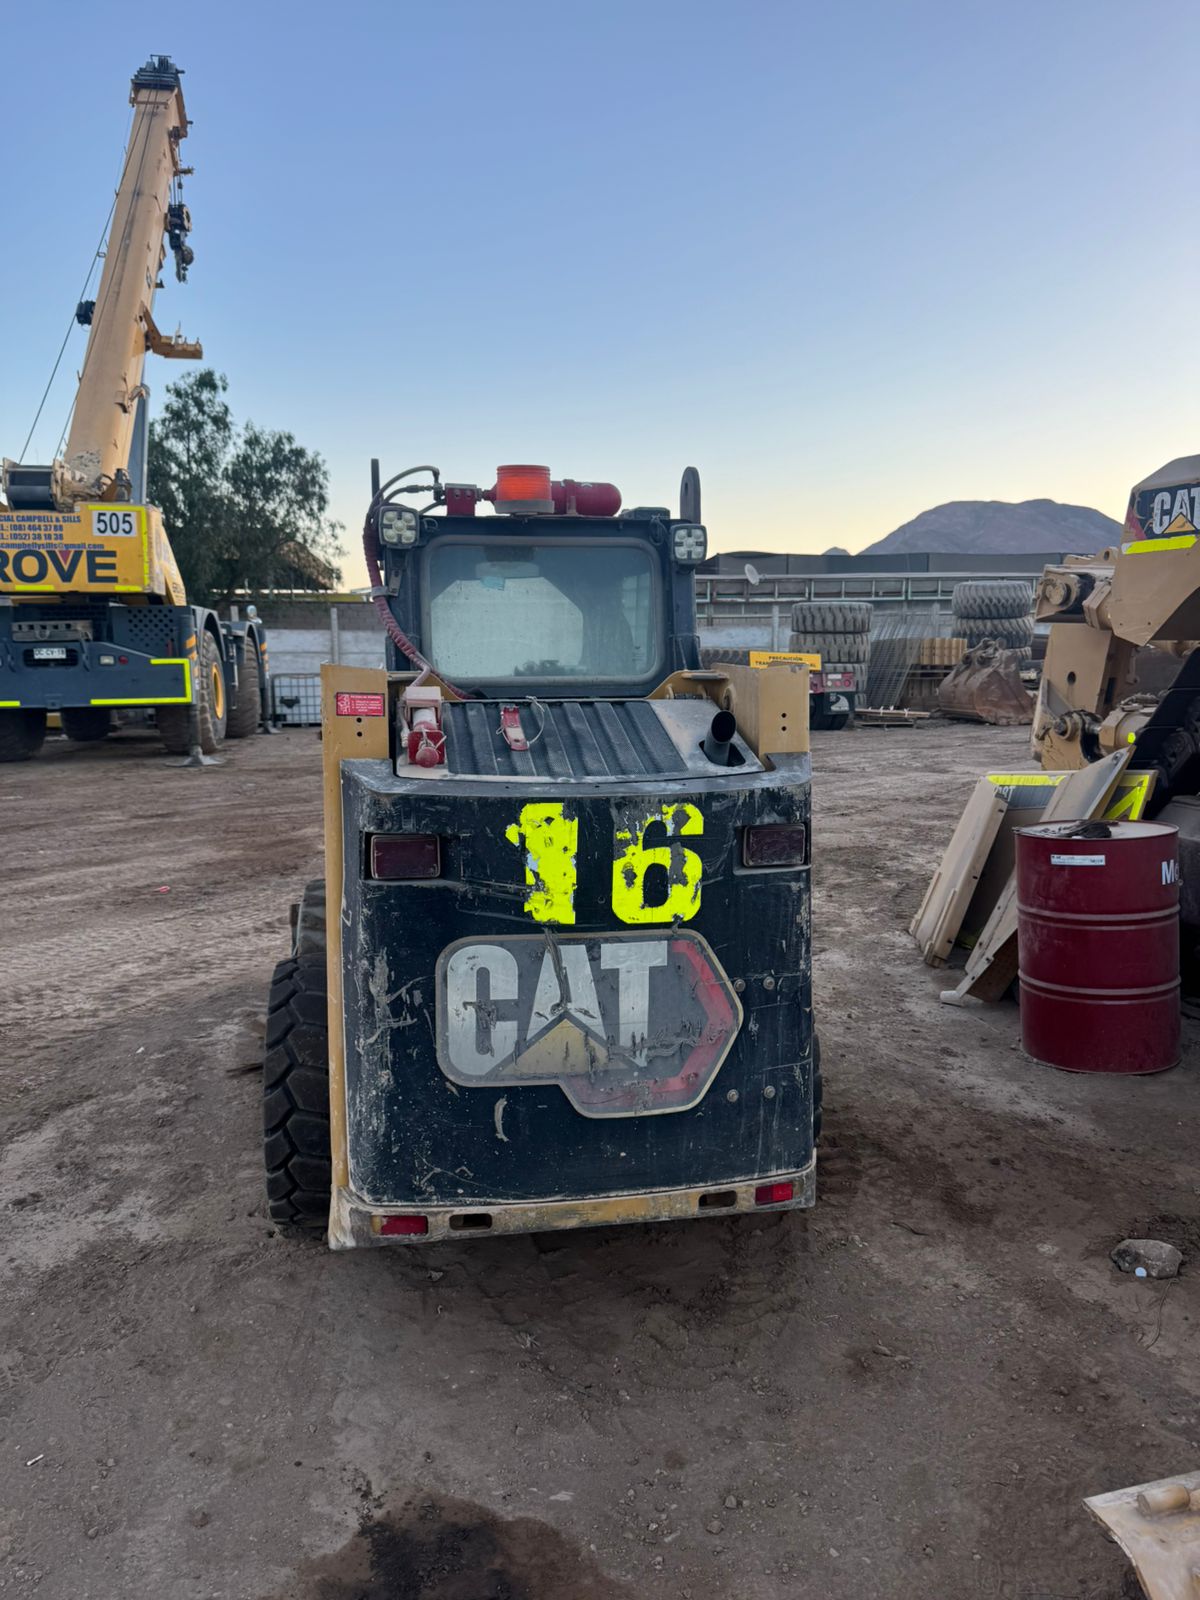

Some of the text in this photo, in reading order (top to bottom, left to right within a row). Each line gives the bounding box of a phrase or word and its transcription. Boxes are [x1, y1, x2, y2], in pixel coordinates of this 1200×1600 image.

[16, 515, 54, 523] CAMPBELL
[97, 512, 133, 535] 505
[1152, 487, 1200, 534] CAT
[505, 803, 704, 924] 16
[447, 941, 668, 1075] CAT
